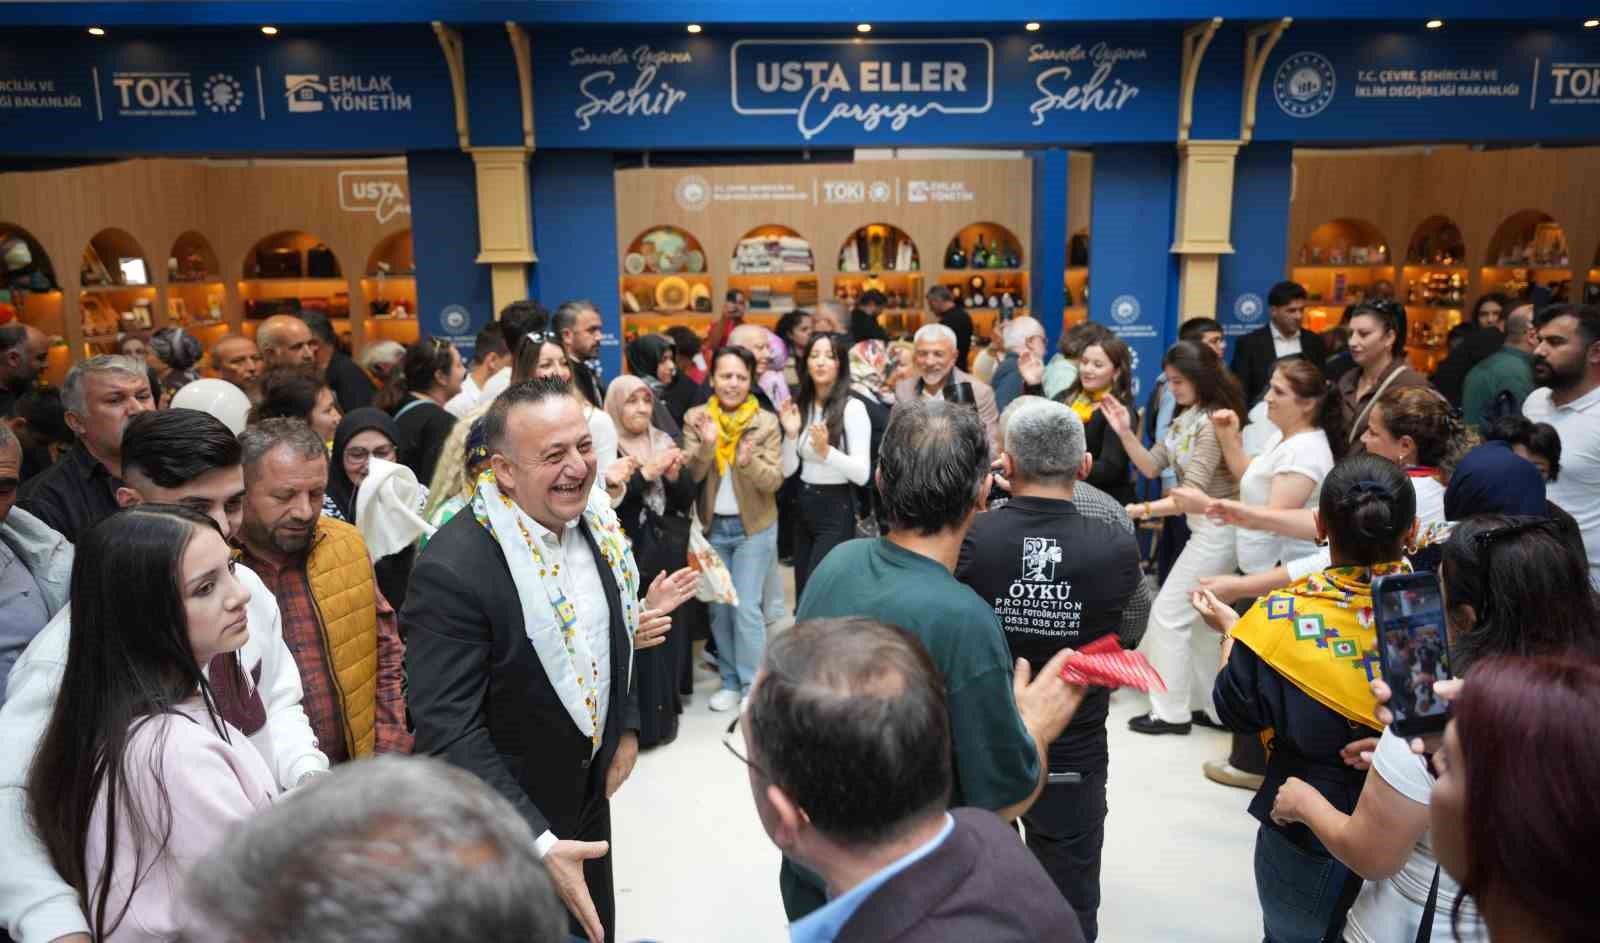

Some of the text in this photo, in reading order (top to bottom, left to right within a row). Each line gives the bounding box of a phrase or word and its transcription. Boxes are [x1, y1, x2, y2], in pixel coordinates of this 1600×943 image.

[329, 75, 392, 92] EMLAK
[757, 61, 968, 93] USTA ELLER
[1358, 70, 1377, 81] T.C.
[1484, 69, 1498, 81] VE
[576, 66, 687, 131] Şehir
[1030, 63, 1139, 126] Şehir
[1355, 82, 1520, 99] İKLİM DEĞİŞİKLİĞİ BAKANLIĞI
[330, 92, 412, 112] YÖNETİM
[351, 182, 403, 201] USTA
[1009, 579, 1072, 600] ÖYKÜ
[995, 598, 1083, 611] PRODUCTION
[1004, 616, 1029, 625] 0533
[1032, 618, 1051, 627] 035
[1053, 619, 1066, 628] 02
